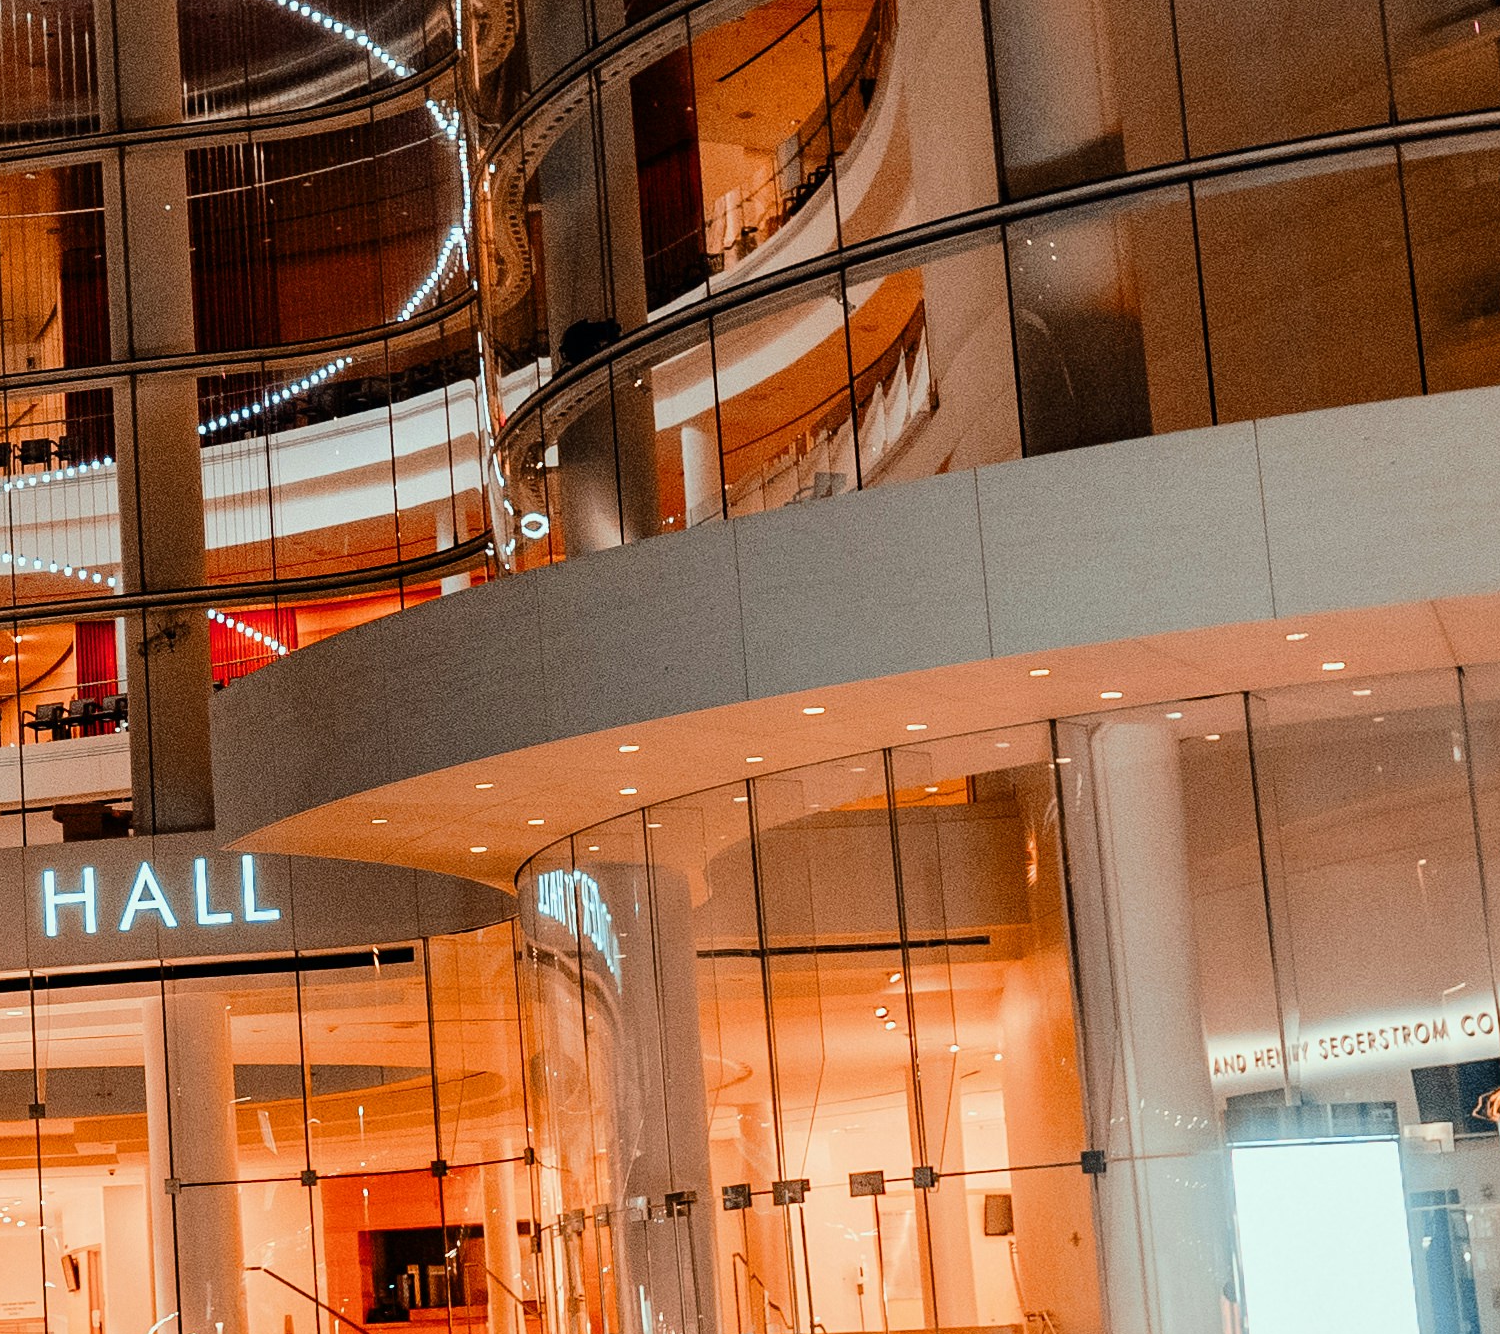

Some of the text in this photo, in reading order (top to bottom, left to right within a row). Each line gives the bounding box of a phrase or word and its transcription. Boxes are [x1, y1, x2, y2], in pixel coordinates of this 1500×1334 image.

[43, 854, 281, 938] HALL
[1213, 1053, 1247, 1079] AND
[1318, 1016, 1450, 1060] SEGERSTROM
